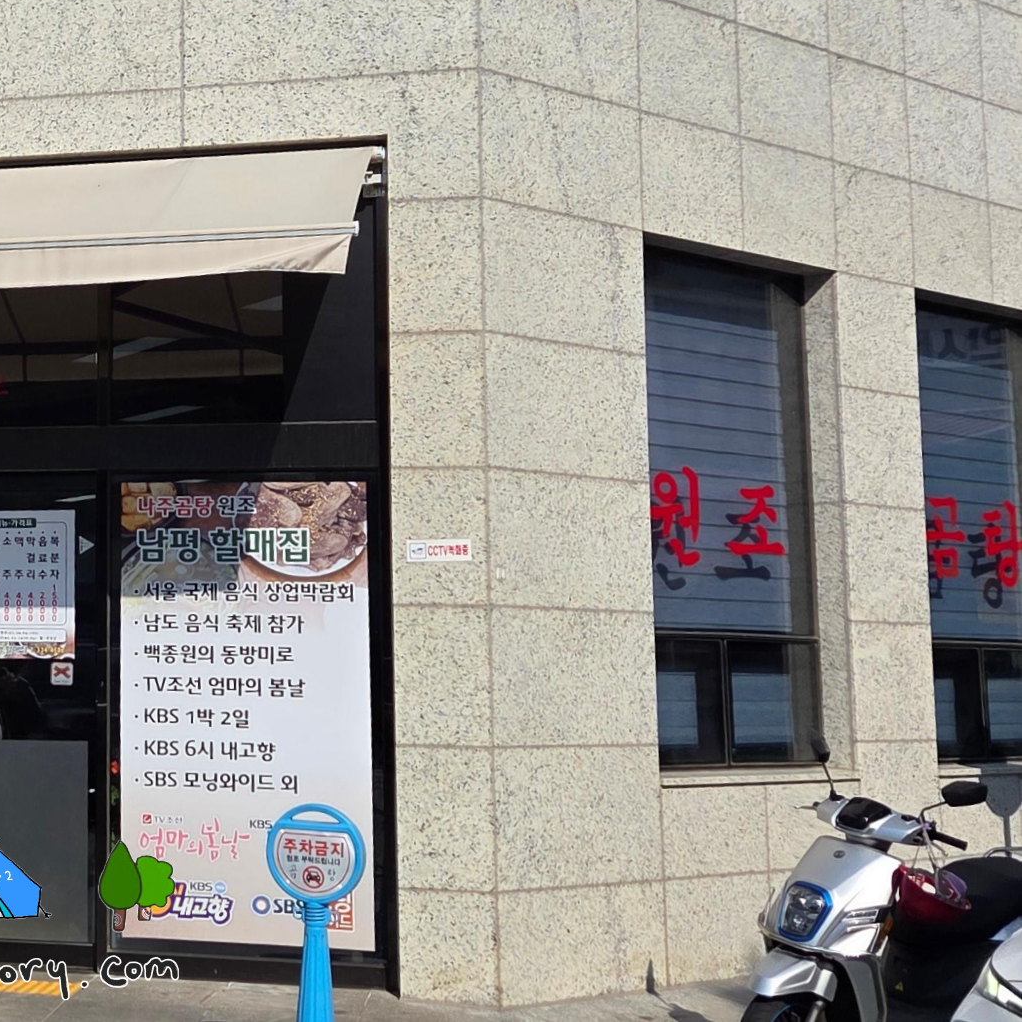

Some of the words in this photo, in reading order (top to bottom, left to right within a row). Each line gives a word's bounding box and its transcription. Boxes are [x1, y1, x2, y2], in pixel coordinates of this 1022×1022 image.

[137, 496, 213, 516] 나주곰탕
[216, 496, 256, 514] 원조
[650, 466, 786, 566] 원조
[136, 528, 201, 564] 남평
[208, 528, 310, 564] 할매집
[924, 495, 1022, 587] 곰탕
[143, 584, 177, 601] 서울
[182, 583, 218, 601] 국제
[223, 584, 258, 601] 음식
[264, 583, 355, 602] 상업박람회
[143, 615, 178, 633] 남도
[184, 615, 219, 633] 음식
[225, 615, 262, 633] 축제
[267, 615, 305, 634] 참가
[143, 645, 215, 664] 백종원의
[221, 646, 294, 664] 동방미로
[143, 677, 203, 696] TV조선
[208, 677, 262, 697] 엄마의
[268, 678, 306, 698] 봄날
[143, 708, 179, 724] KBS
[186, 709, 215, 727] 1박
[220, 709, 250, 728] 2일
[143, 740, 179, 756] KBS
[184, 740, 214, 760] 6시
[221, 741, 276, 761] 내고향
[143, 772, 177, 787] SBS
[183, 773, 275, 792] 모닝와이드
[280, 775, 299, 794] 외
[249, 819, 273, 829] KBS
[140, 828, 203, 859] 엄마의
[201, 817, 251, 860] 봄날
[283, 837, 345, 859] 주차금지
[190, 882, 213, 892] KBS
[172, 894, 231, 923] 내고향
